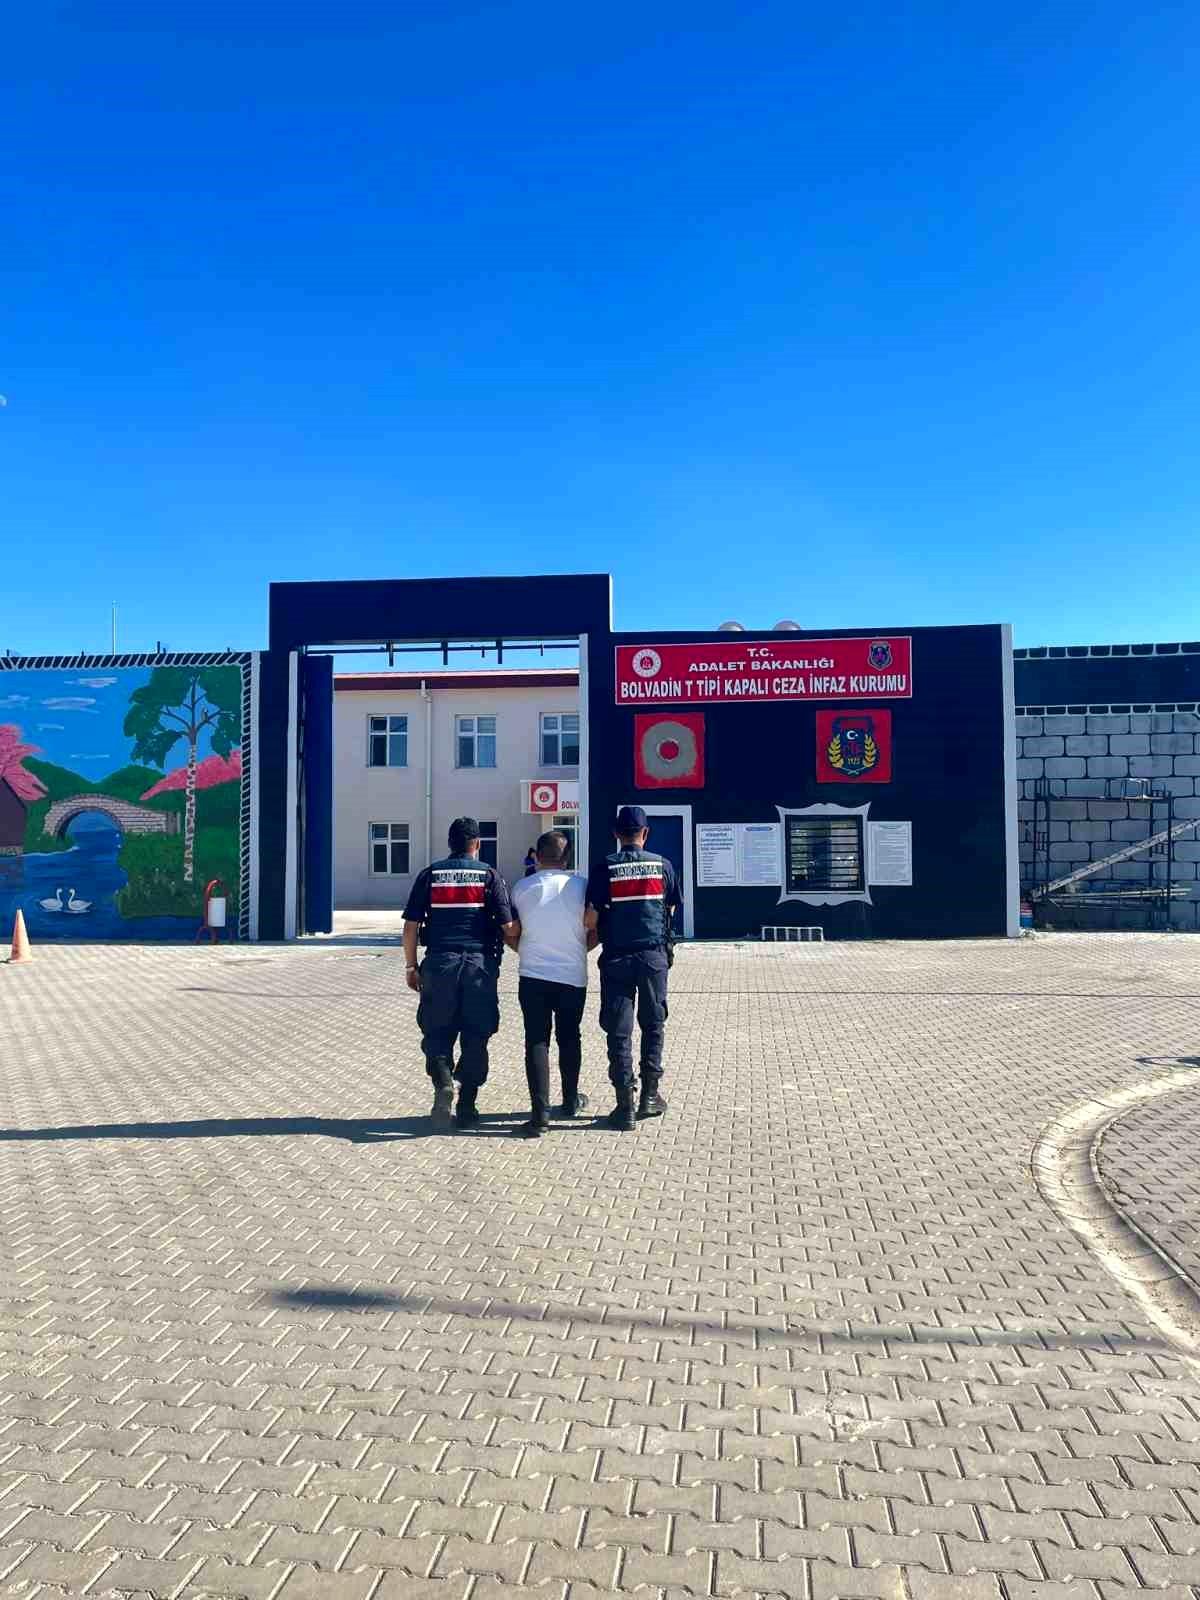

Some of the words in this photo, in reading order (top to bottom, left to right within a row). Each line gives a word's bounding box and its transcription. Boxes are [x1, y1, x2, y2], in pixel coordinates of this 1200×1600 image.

[747, 648, 774, 657] T.C.
[688, 661, 746, 672] ADALET
[751, 657, 834, 671] BAKANLIĞI
[621, 677, 682, 698] BOLVADİN
[685, 681, 693, 697] T
[696, 676, 721, 697] TİPİ
[724, 678, 769, 696] KAPALI
[772, 677, 806, 694] CEZA
[809, 673, 846, 693] İNFAZ
[850, 674, 907, 693] KURUMU
[561, 800, 580, 809] BOLV
